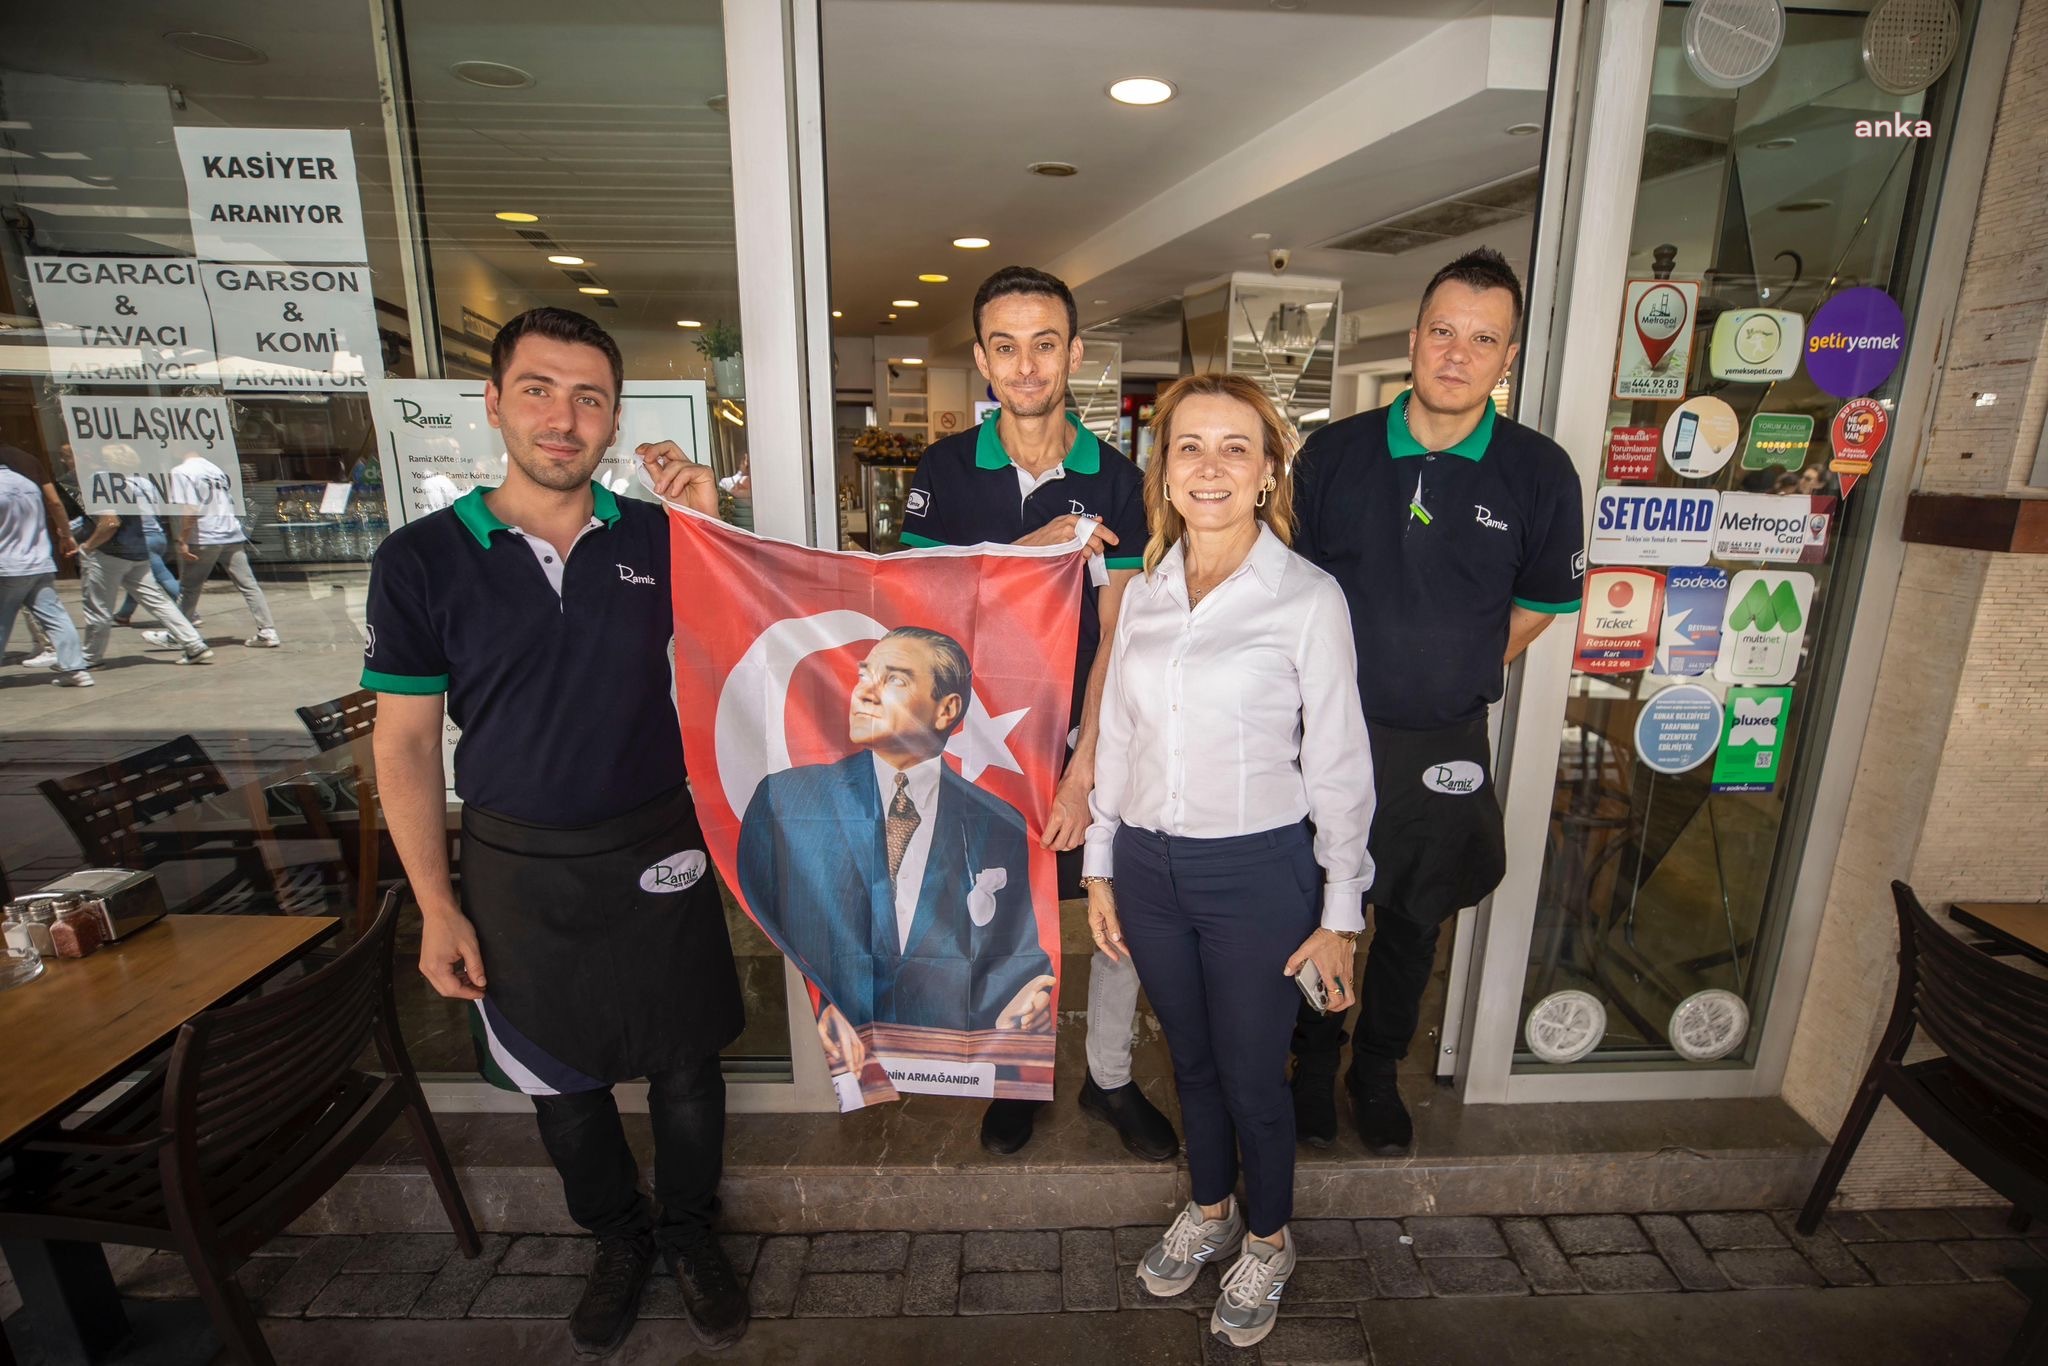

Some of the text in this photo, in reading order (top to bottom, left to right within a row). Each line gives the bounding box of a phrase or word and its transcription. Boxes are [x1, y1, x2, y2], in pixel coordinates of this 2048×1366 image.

[203, 151, 338, 180] KASİYER
[210, 204, 344, 224] ARANIYOR
[34, 262, 196, 285] IZGARACI
[216, 269, 360, 293] GARSON
[115, 295, 138, 316] &
[283, 301, 304, 322] &
[1641, 316, 1677, 326] Metropol
[79, 326, 187, 346] TAVACI
[256, 327, 340, 353] KOMİ
[1808, 332, 1901, 353] getiryemek
[67, 363, 200, 380] ARANIYOR
[236, 369, 367, 387] ARANIYOR
[1724, 367, 1783, 376] yemeksepeti.com
[1631, 379, 1679, 388] 444 92 83
[393, 398, 452, 428] Ramiz
[1840, 400, 1885, 423] BU RESTORAN
[71, 406, 224, 449] BULAŞIKÇI
[1846, 423, 1874, 433] YEMEK
[408, 455, 432, 463] Ramiz
[434, 455, 455, 463] Köfte
[1613, 453, 1652, 462] bekliyoruz!
[469, 471, 490, 479] Köfte
[1474, 504, 1508, 531] Ramiz
[1597, 495, 1714, 532] SETCARD
[1720, 512, 1808, 536] Metropol
[1777, 533, 1804, 544] Card
[615, 563, 656, 585] Ramiz
[1671, 571, 1728, 589] sodexo
[1595, 617, 1634, 629] Ticket
[1585, 638, 1641, 648] Restaurant
[1742, 634, 1780, 644] multinet
[1603, 649, 1620, 658] Kart
[1731, 714, 1780, 729] pluxee
[1434, 765, 1474, 789] Ramiz
[648, 864, 699, 887] Ramiz
[907, 1072, 980, 1086] ARMAĞANIDIR
